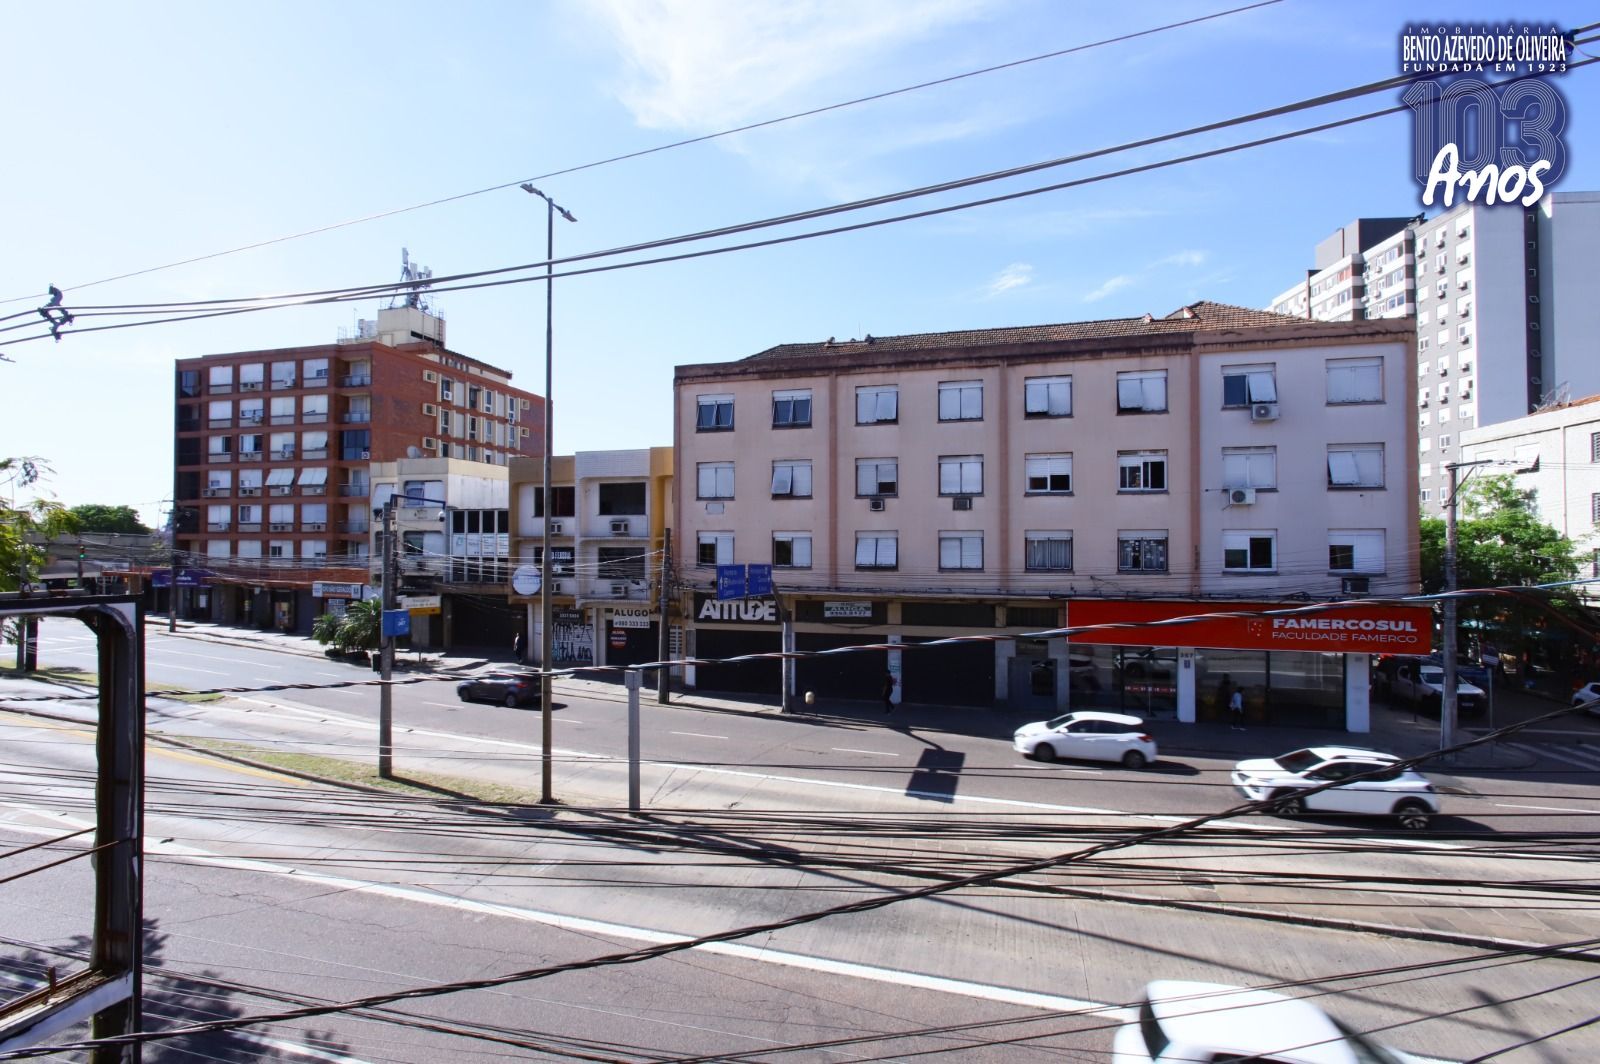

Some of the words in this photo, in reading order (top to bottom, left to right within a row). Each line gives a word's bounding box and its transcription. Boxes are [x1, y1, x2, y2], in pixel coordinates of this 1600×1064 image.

[614, 609, 649, 617] ALUGO
[698, 599, 777, 621] ATITUDE
[1272, 618, 1418, 632] FAMERCOSUL
[1272, 631, 1348, 641] FACULDADE
[1351, 633, 1418, 643] FAMERCO
